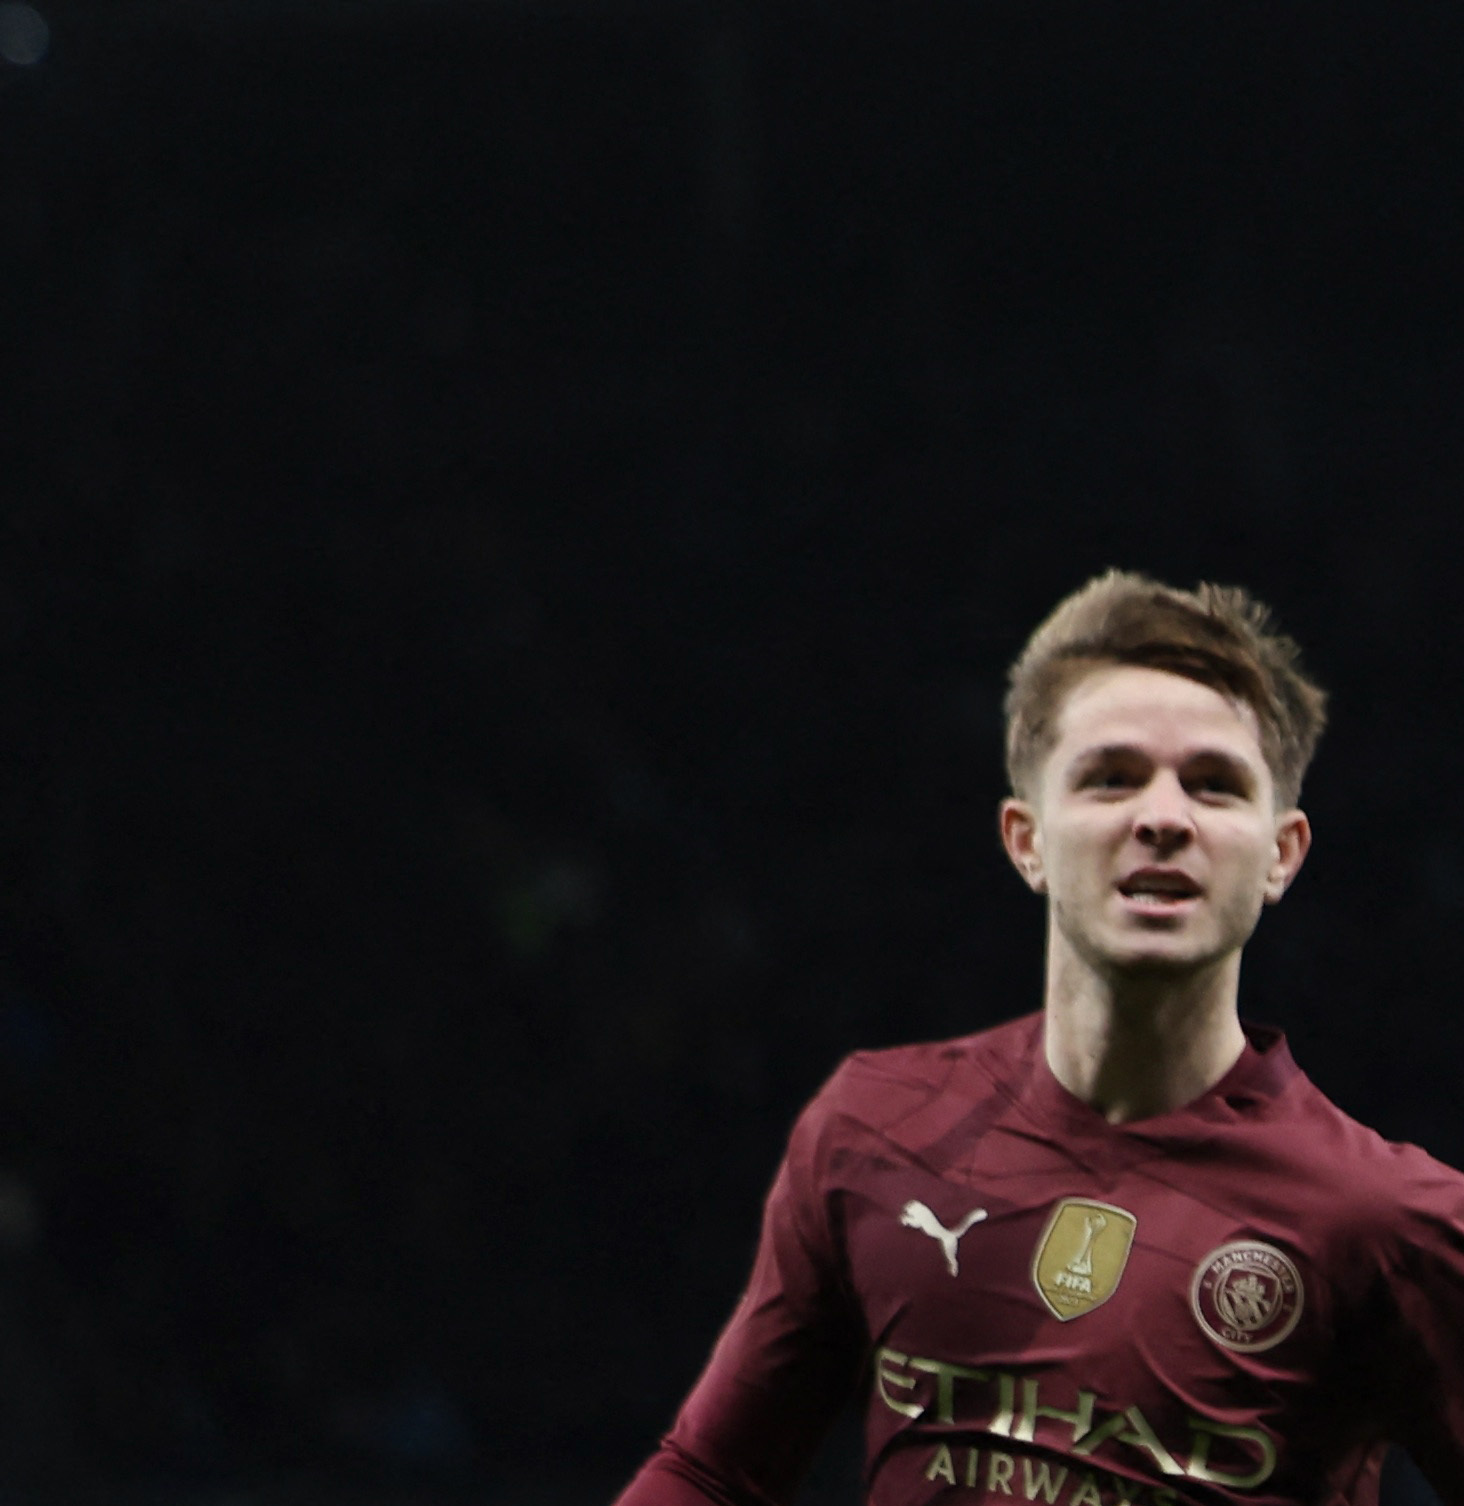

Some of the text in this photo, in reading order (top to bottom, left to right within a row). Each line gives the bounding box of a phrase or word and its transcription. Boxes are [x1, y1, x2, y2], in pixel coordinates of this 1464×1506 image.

[1055, 1271, 1092, 1294] FIFA
[1210, 1250, 1295, 1293] MANCHESTER
[874, 1347, 1278, 1489] ETIHAD
